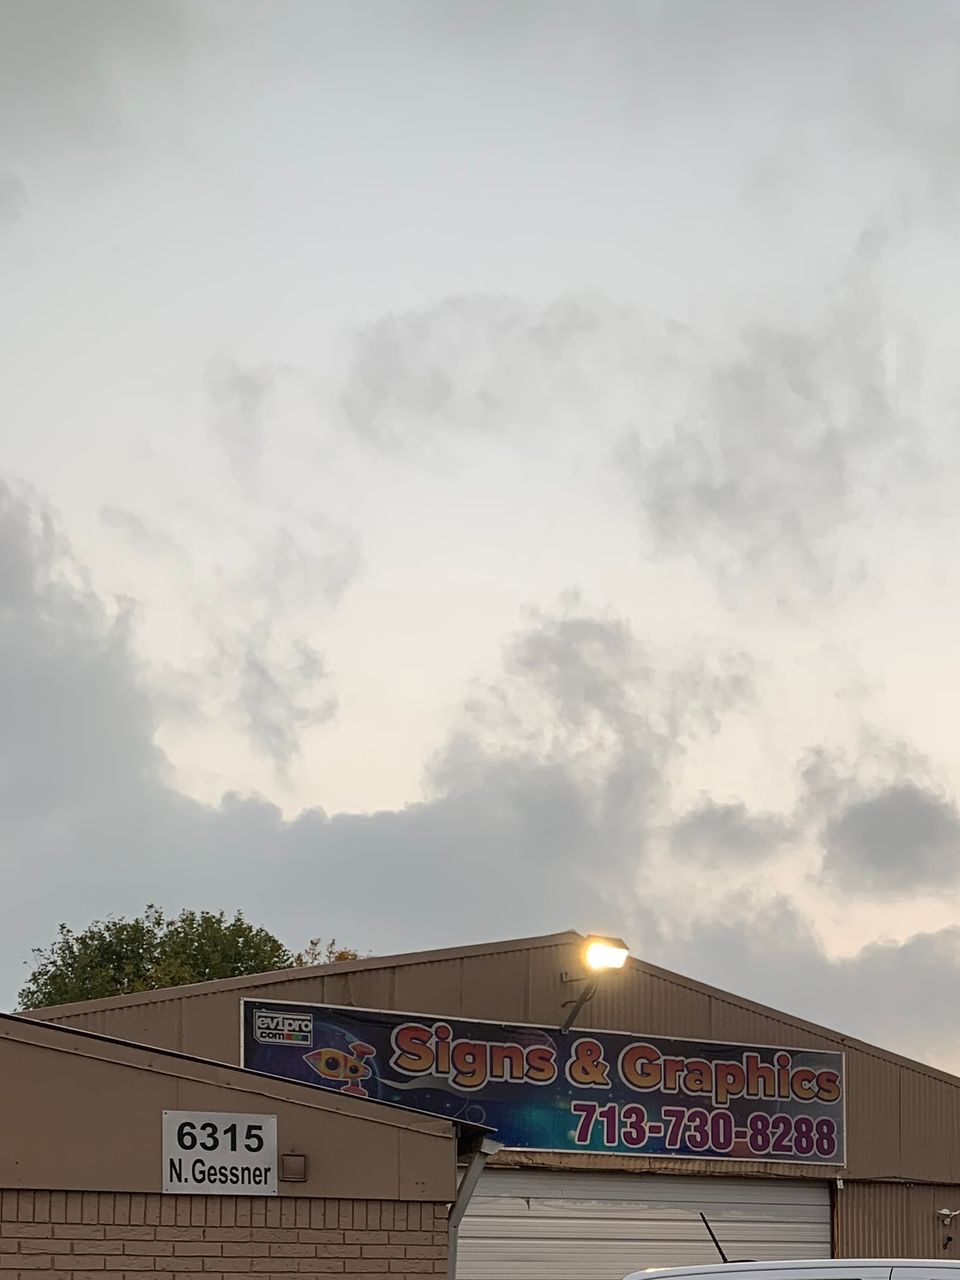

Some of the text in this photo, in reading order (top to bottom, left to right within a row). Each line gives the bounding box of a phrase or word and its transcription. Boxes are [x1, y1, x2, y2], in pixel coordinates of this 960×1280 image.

[390, 1022, 842, 1106] Signs & Graphics
[177, 1121, 264, 1152] 6315
[572, 1100, 837, 1157] 713-730-8288
[191, 1158, 271, 1185] Gessner
